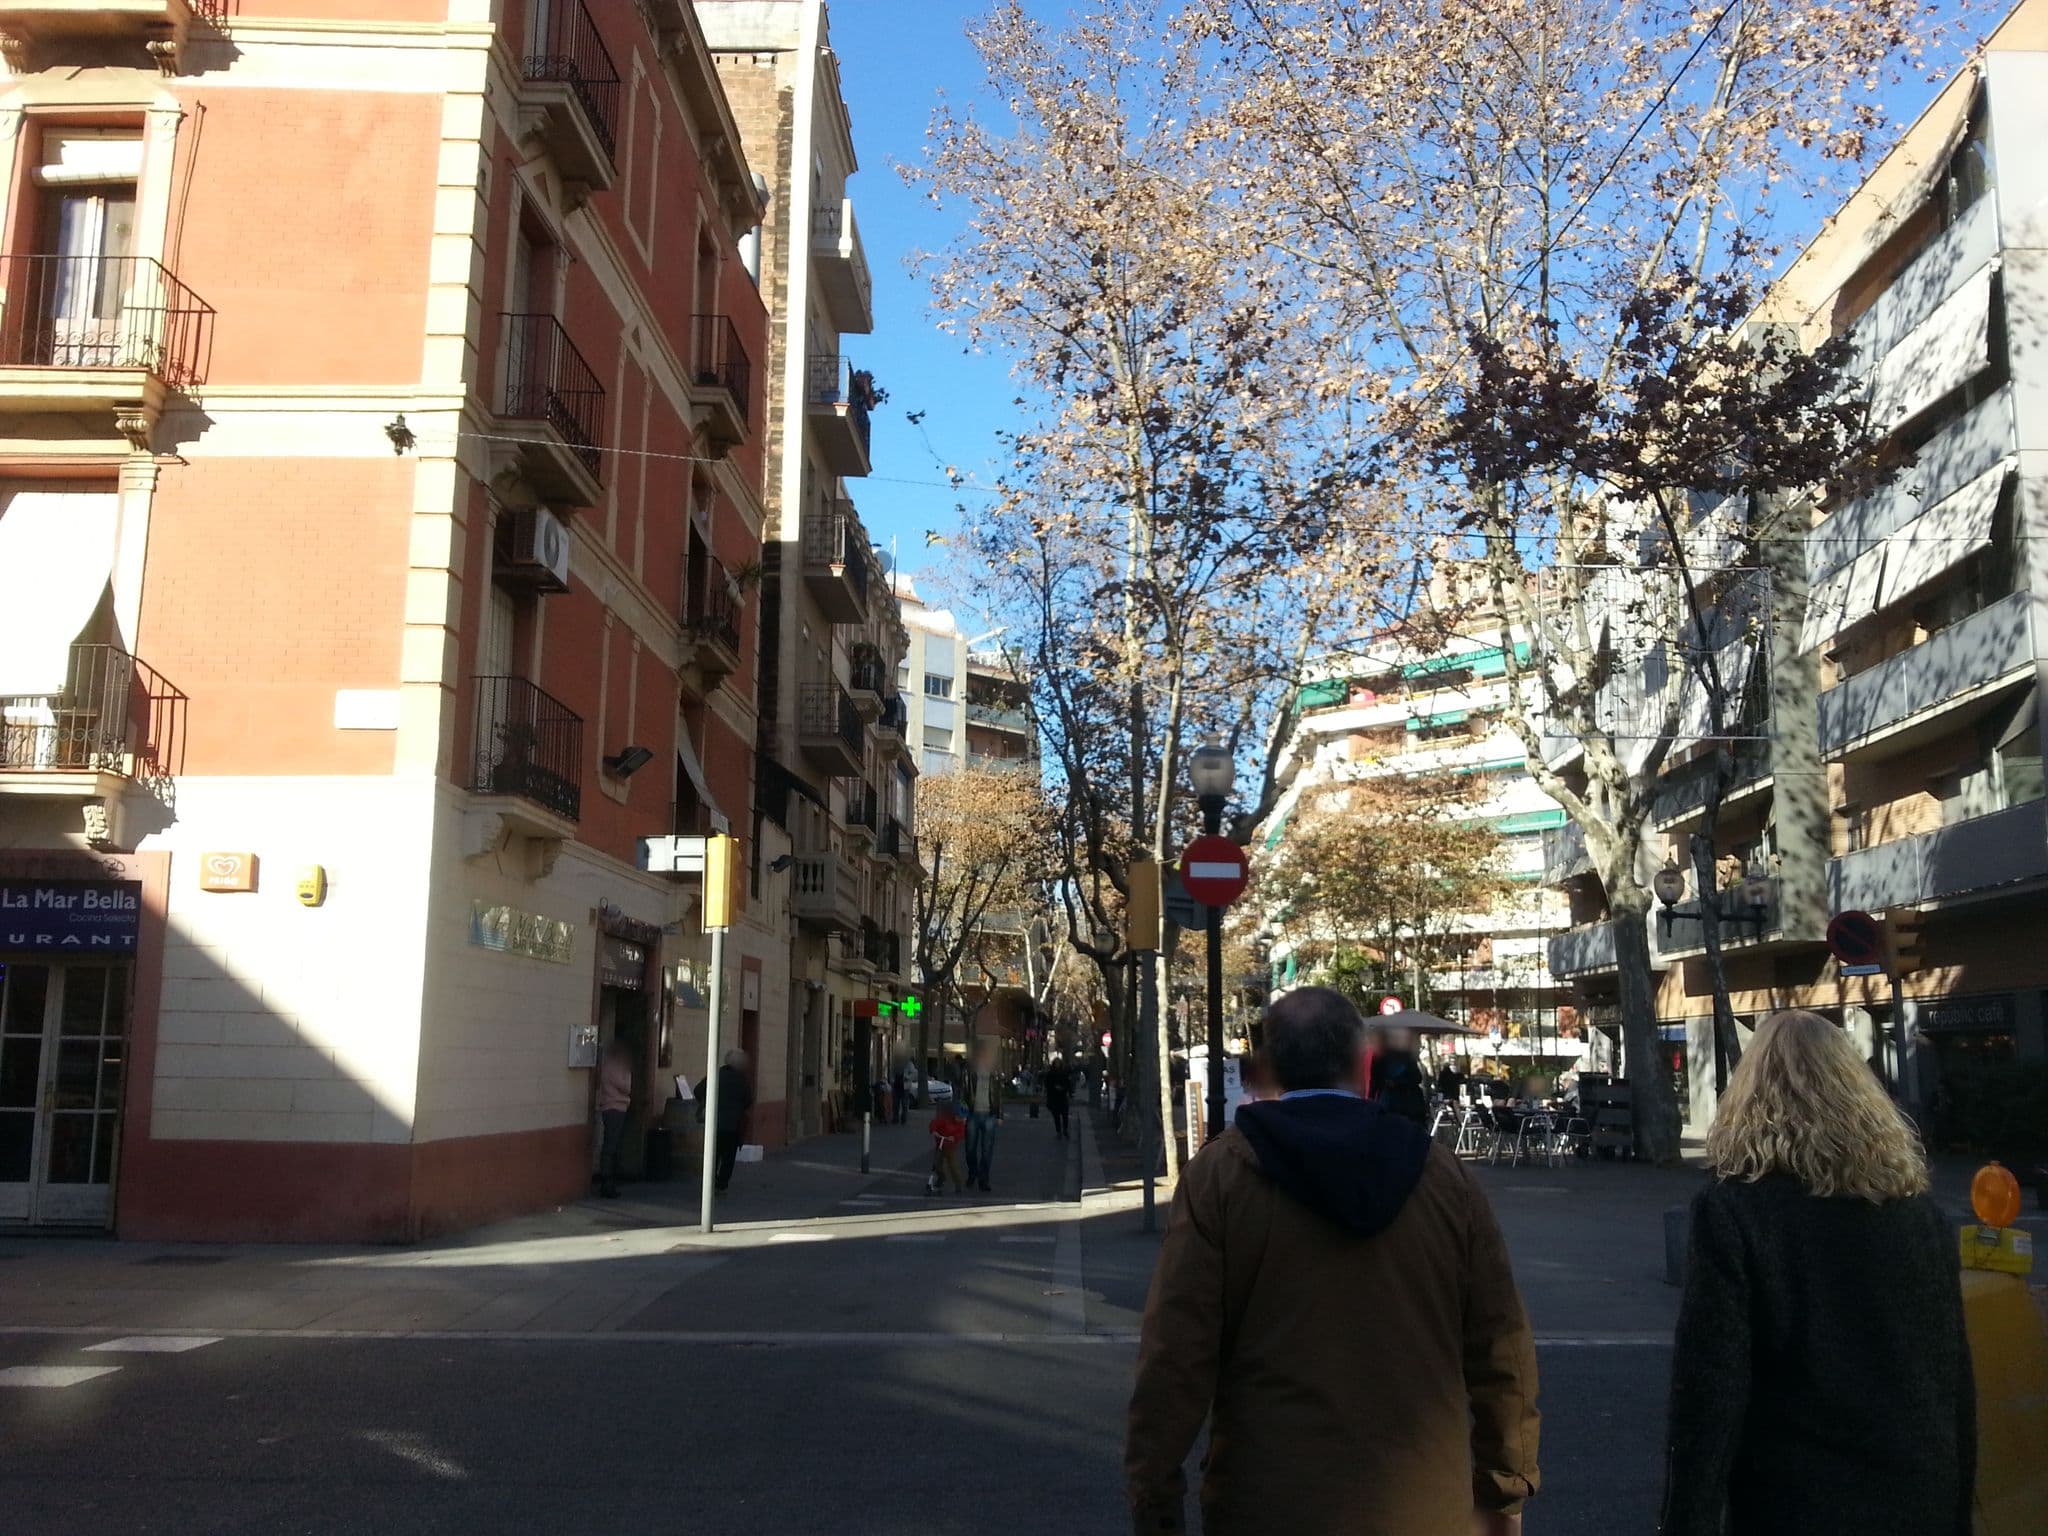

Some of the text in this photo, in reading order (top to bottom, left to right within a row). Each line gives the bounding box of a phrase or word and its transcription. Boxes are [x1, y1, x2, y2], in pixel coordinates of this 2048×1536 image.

[2, 888, 137, 909] La Mar Bella
[8, 933, 136, 945] URANT
